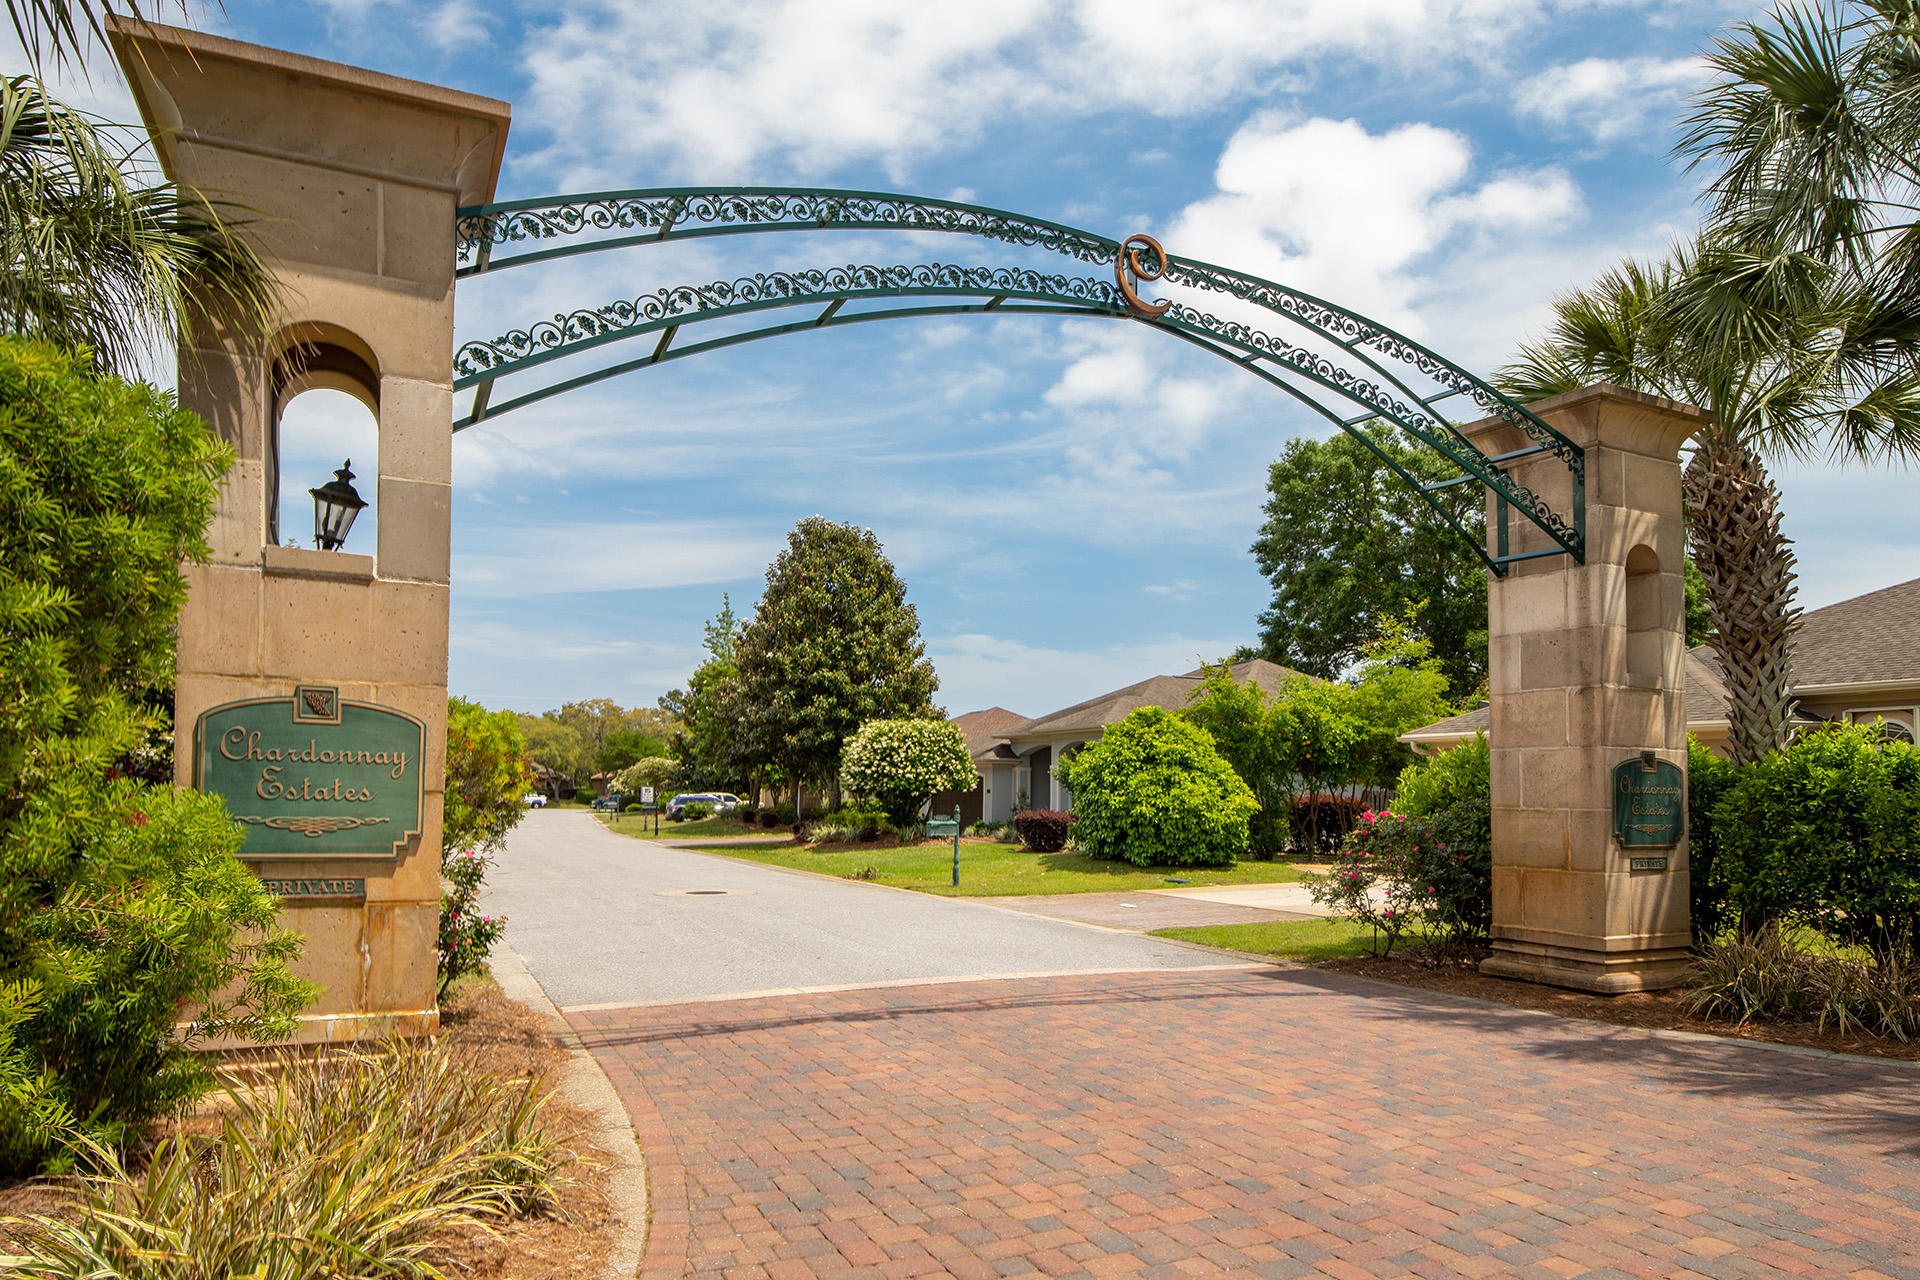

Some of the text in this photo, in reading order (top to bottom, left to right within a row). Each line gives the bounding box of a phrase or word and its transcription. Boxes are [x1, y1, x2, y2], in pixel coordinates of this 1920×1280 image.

[219, 726, 413, 779] Chardonnay
[256, 765, 378, 801] Estates
[1620, 775, 1680, 801] Chardonnay
[1631, 796, 1671, 815] Estates
[266, 879, 355, 895] PRIVATE
